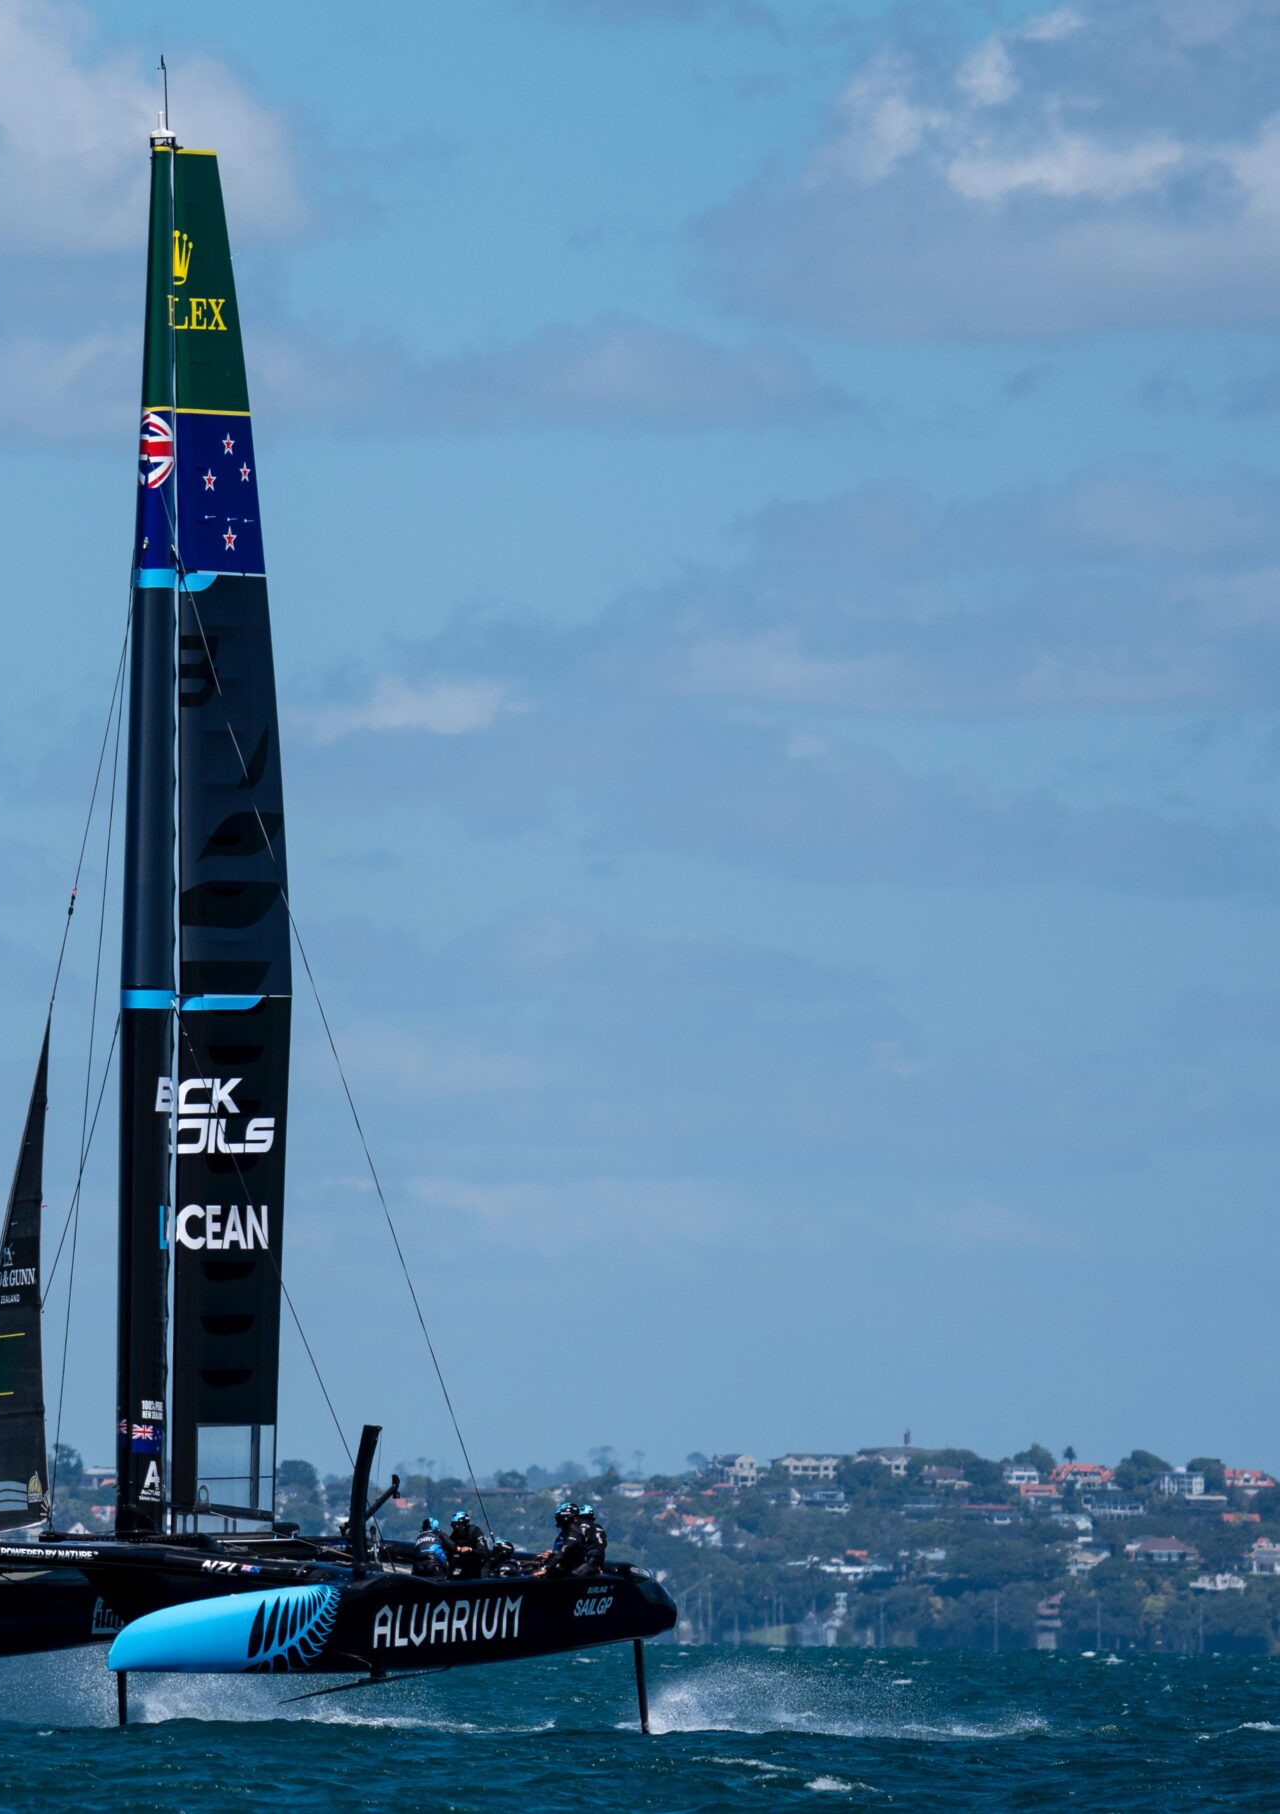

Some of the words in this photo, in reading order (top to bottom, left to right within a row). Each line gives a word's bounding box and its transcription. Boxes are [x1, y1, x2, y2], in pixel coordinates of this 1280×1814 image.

[0, 1547, 44, 1559] POWERED
[45, 1549, 57, 1559] BY
[202, 1559, 239, 1576] NZL
[373, 1595, 523, 1649] ALVARIUM
